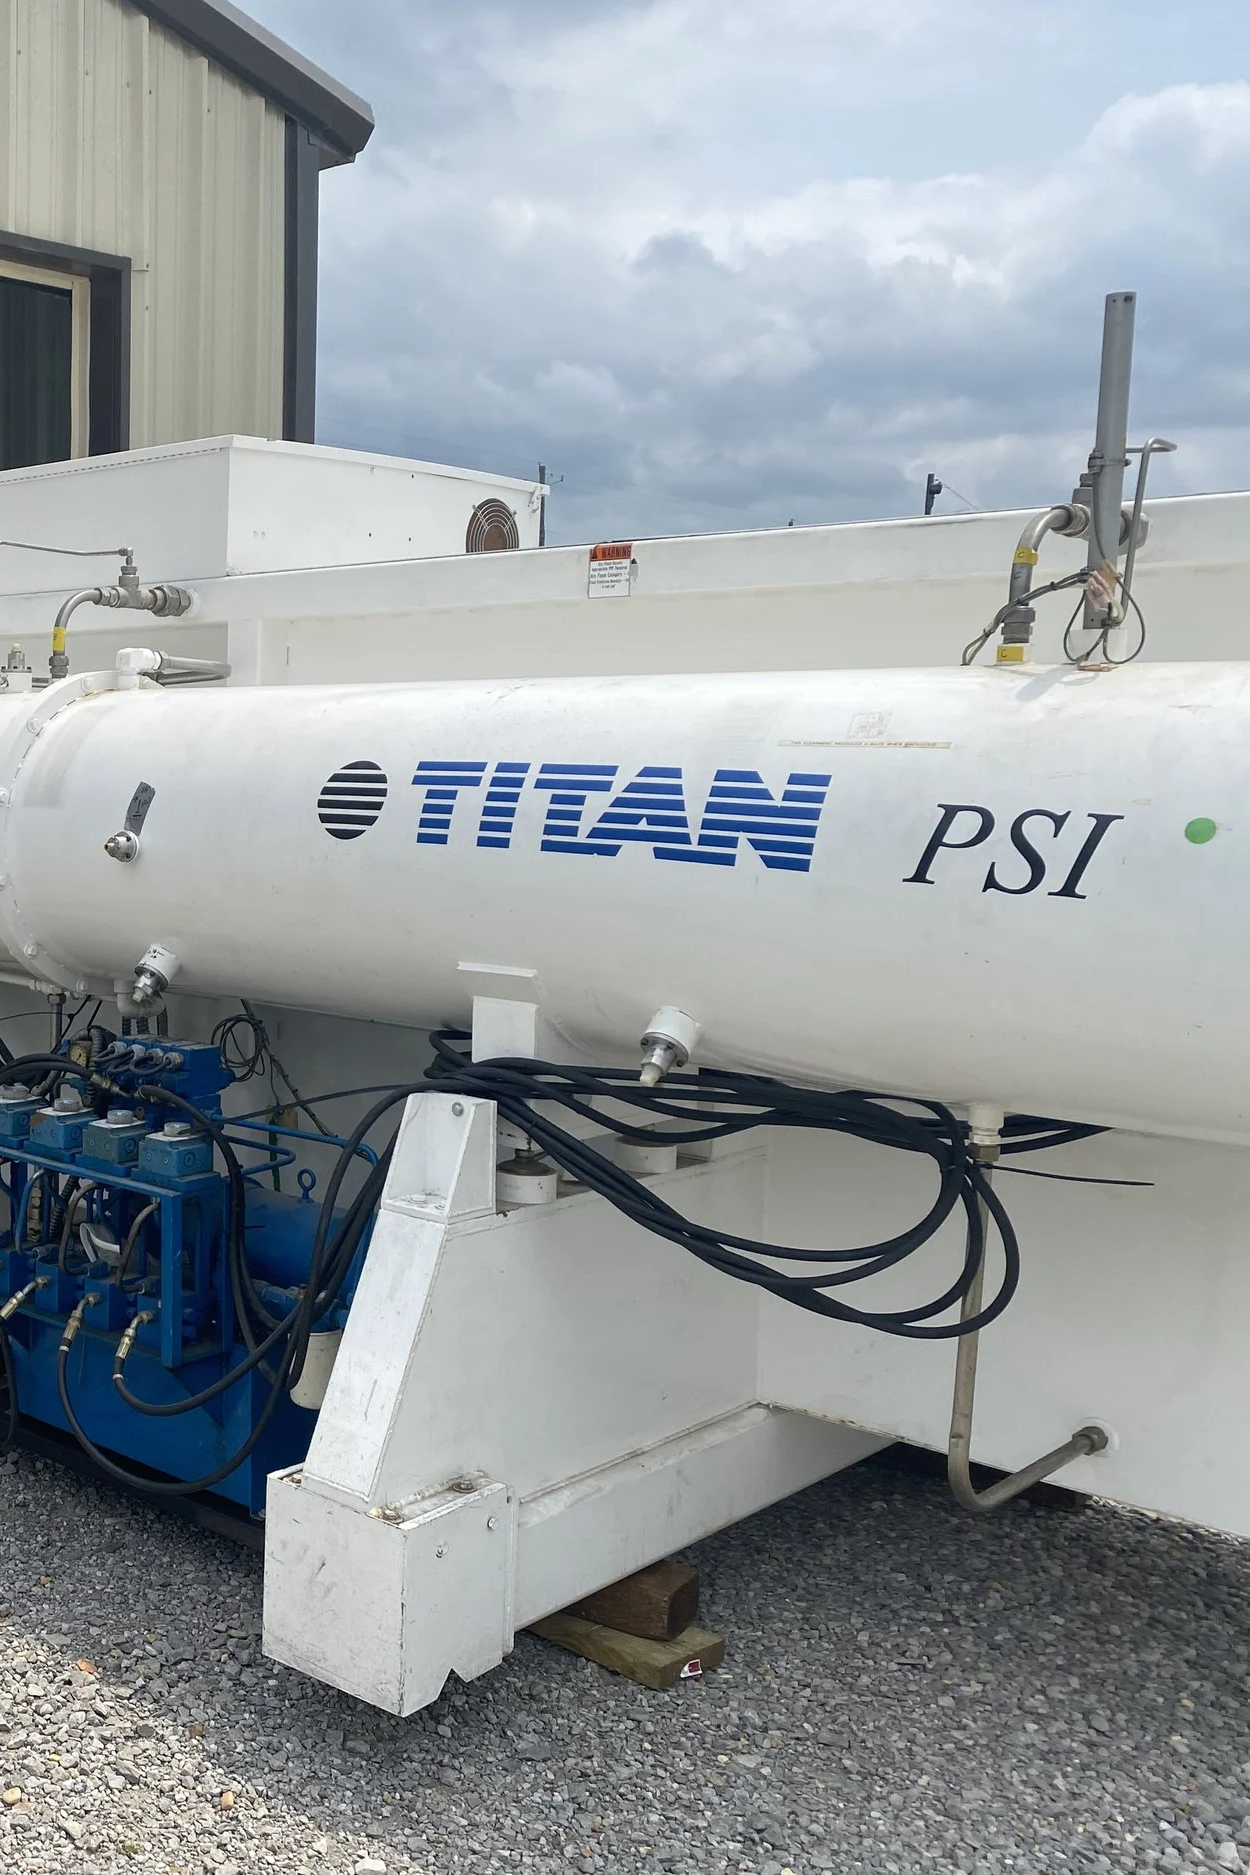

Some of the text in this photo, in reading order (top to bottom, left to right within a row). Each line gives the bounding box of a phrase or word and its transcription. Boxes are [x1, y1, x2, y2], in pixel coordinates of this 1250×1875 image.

[602, 546, 631, 559] WARNING
[412, 761, 1124, 899] TITAN PSI
